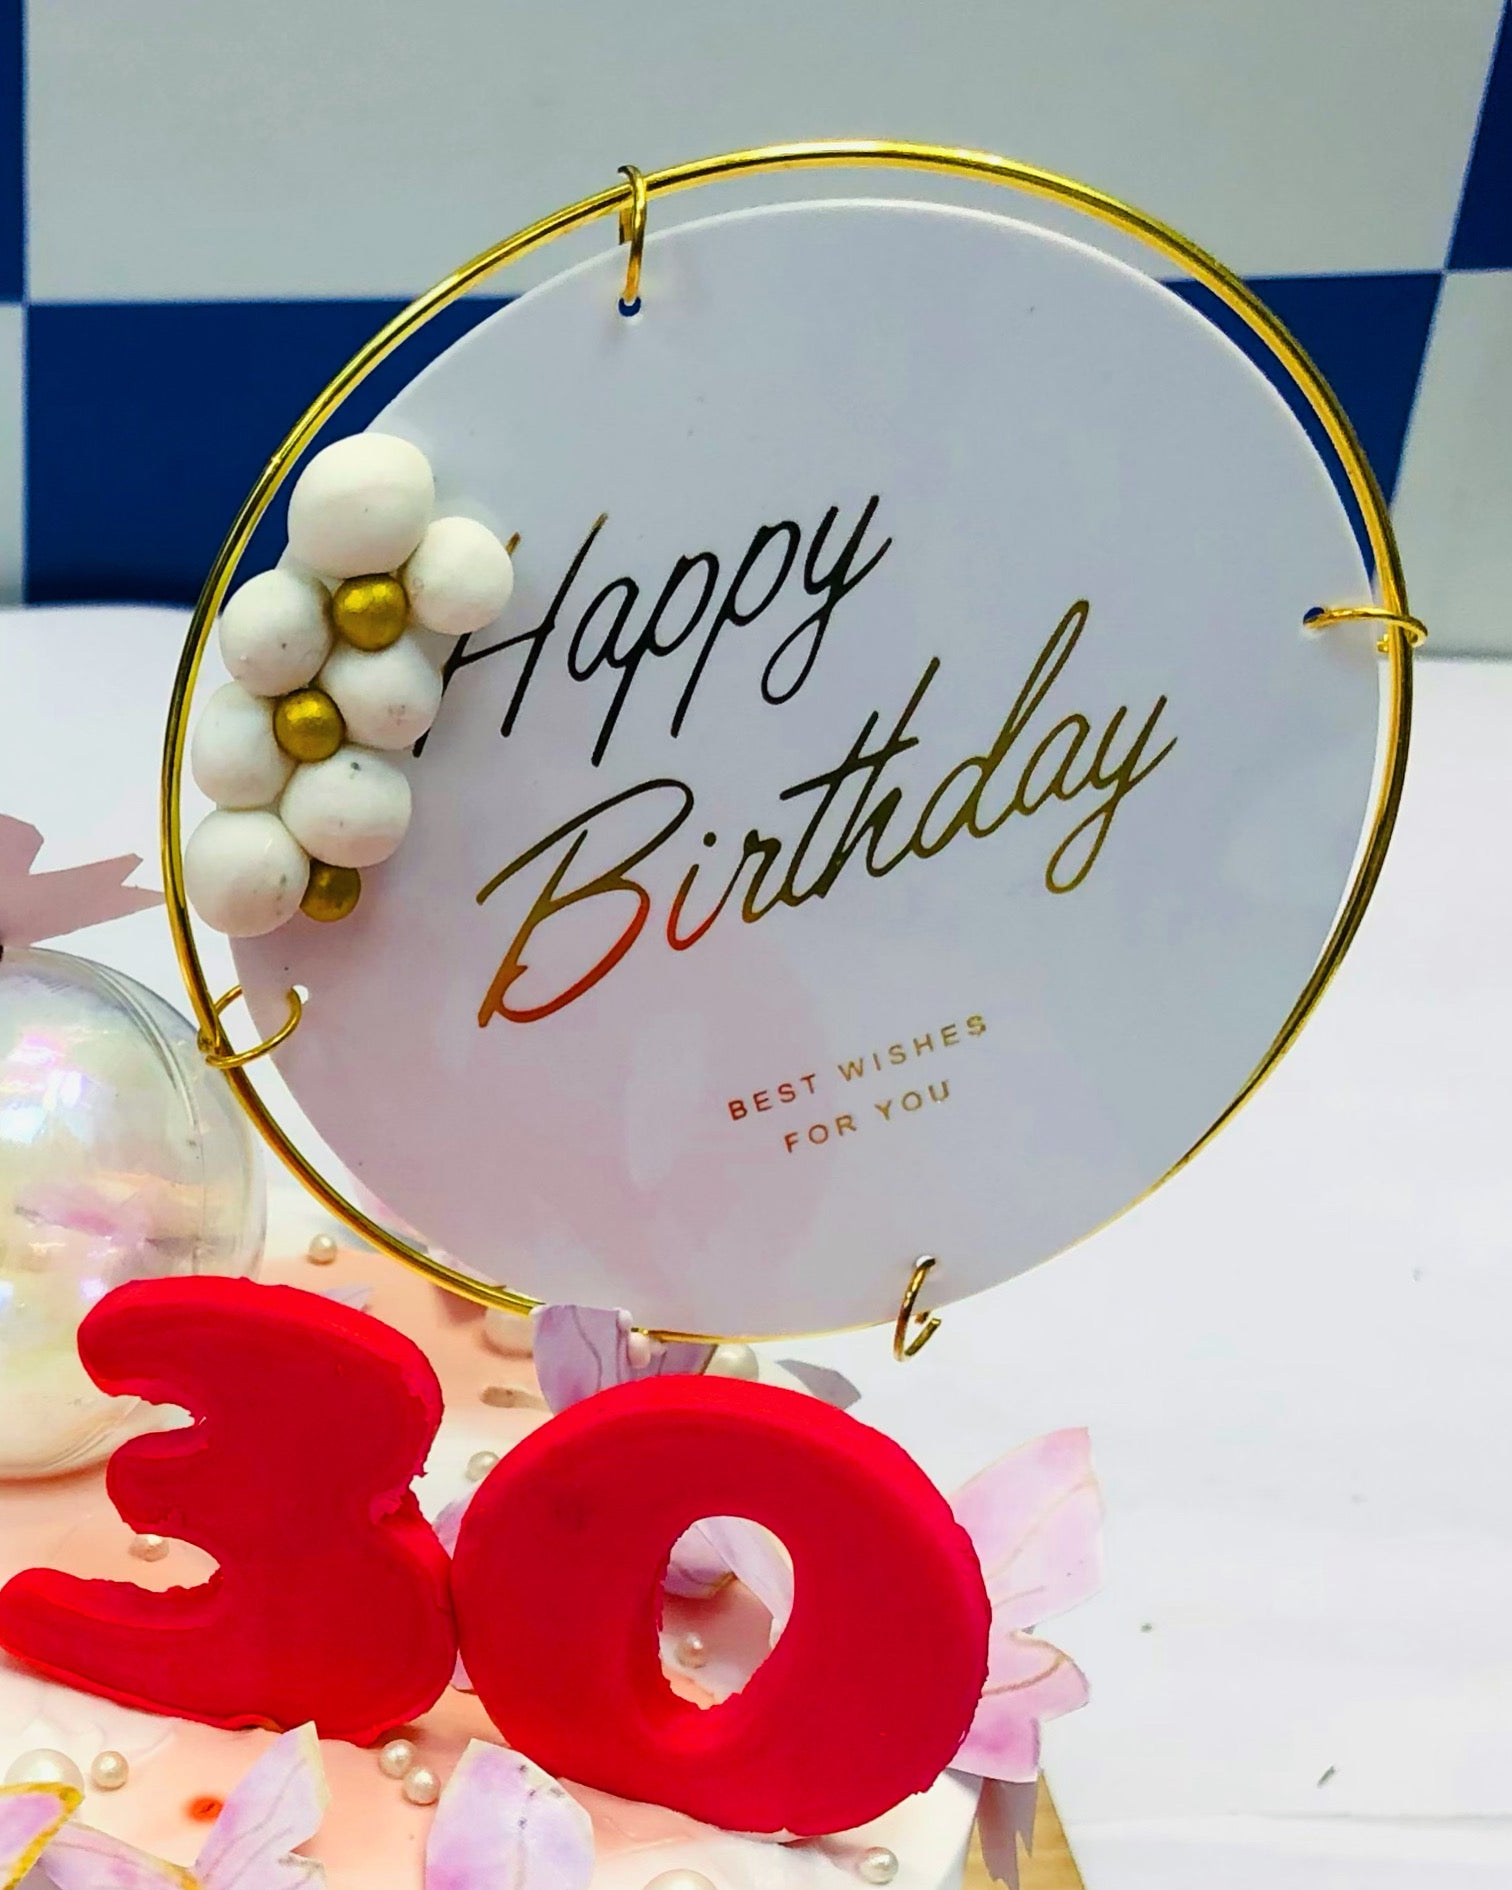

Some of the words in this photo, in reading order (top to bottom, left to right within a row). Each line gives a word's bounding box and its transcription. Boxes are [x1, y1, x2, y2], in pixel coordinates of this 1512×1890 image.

[412, 494, 893, 768] Happy
[476, 600, 1179, 1028] Birthday
[728, 1073, 820, 1122] BEST
[837, 1013, 990, 1083] WISHES
[783, 1113, 858, 1154] FOR
[874, 1079, 953, 1122] YOU
